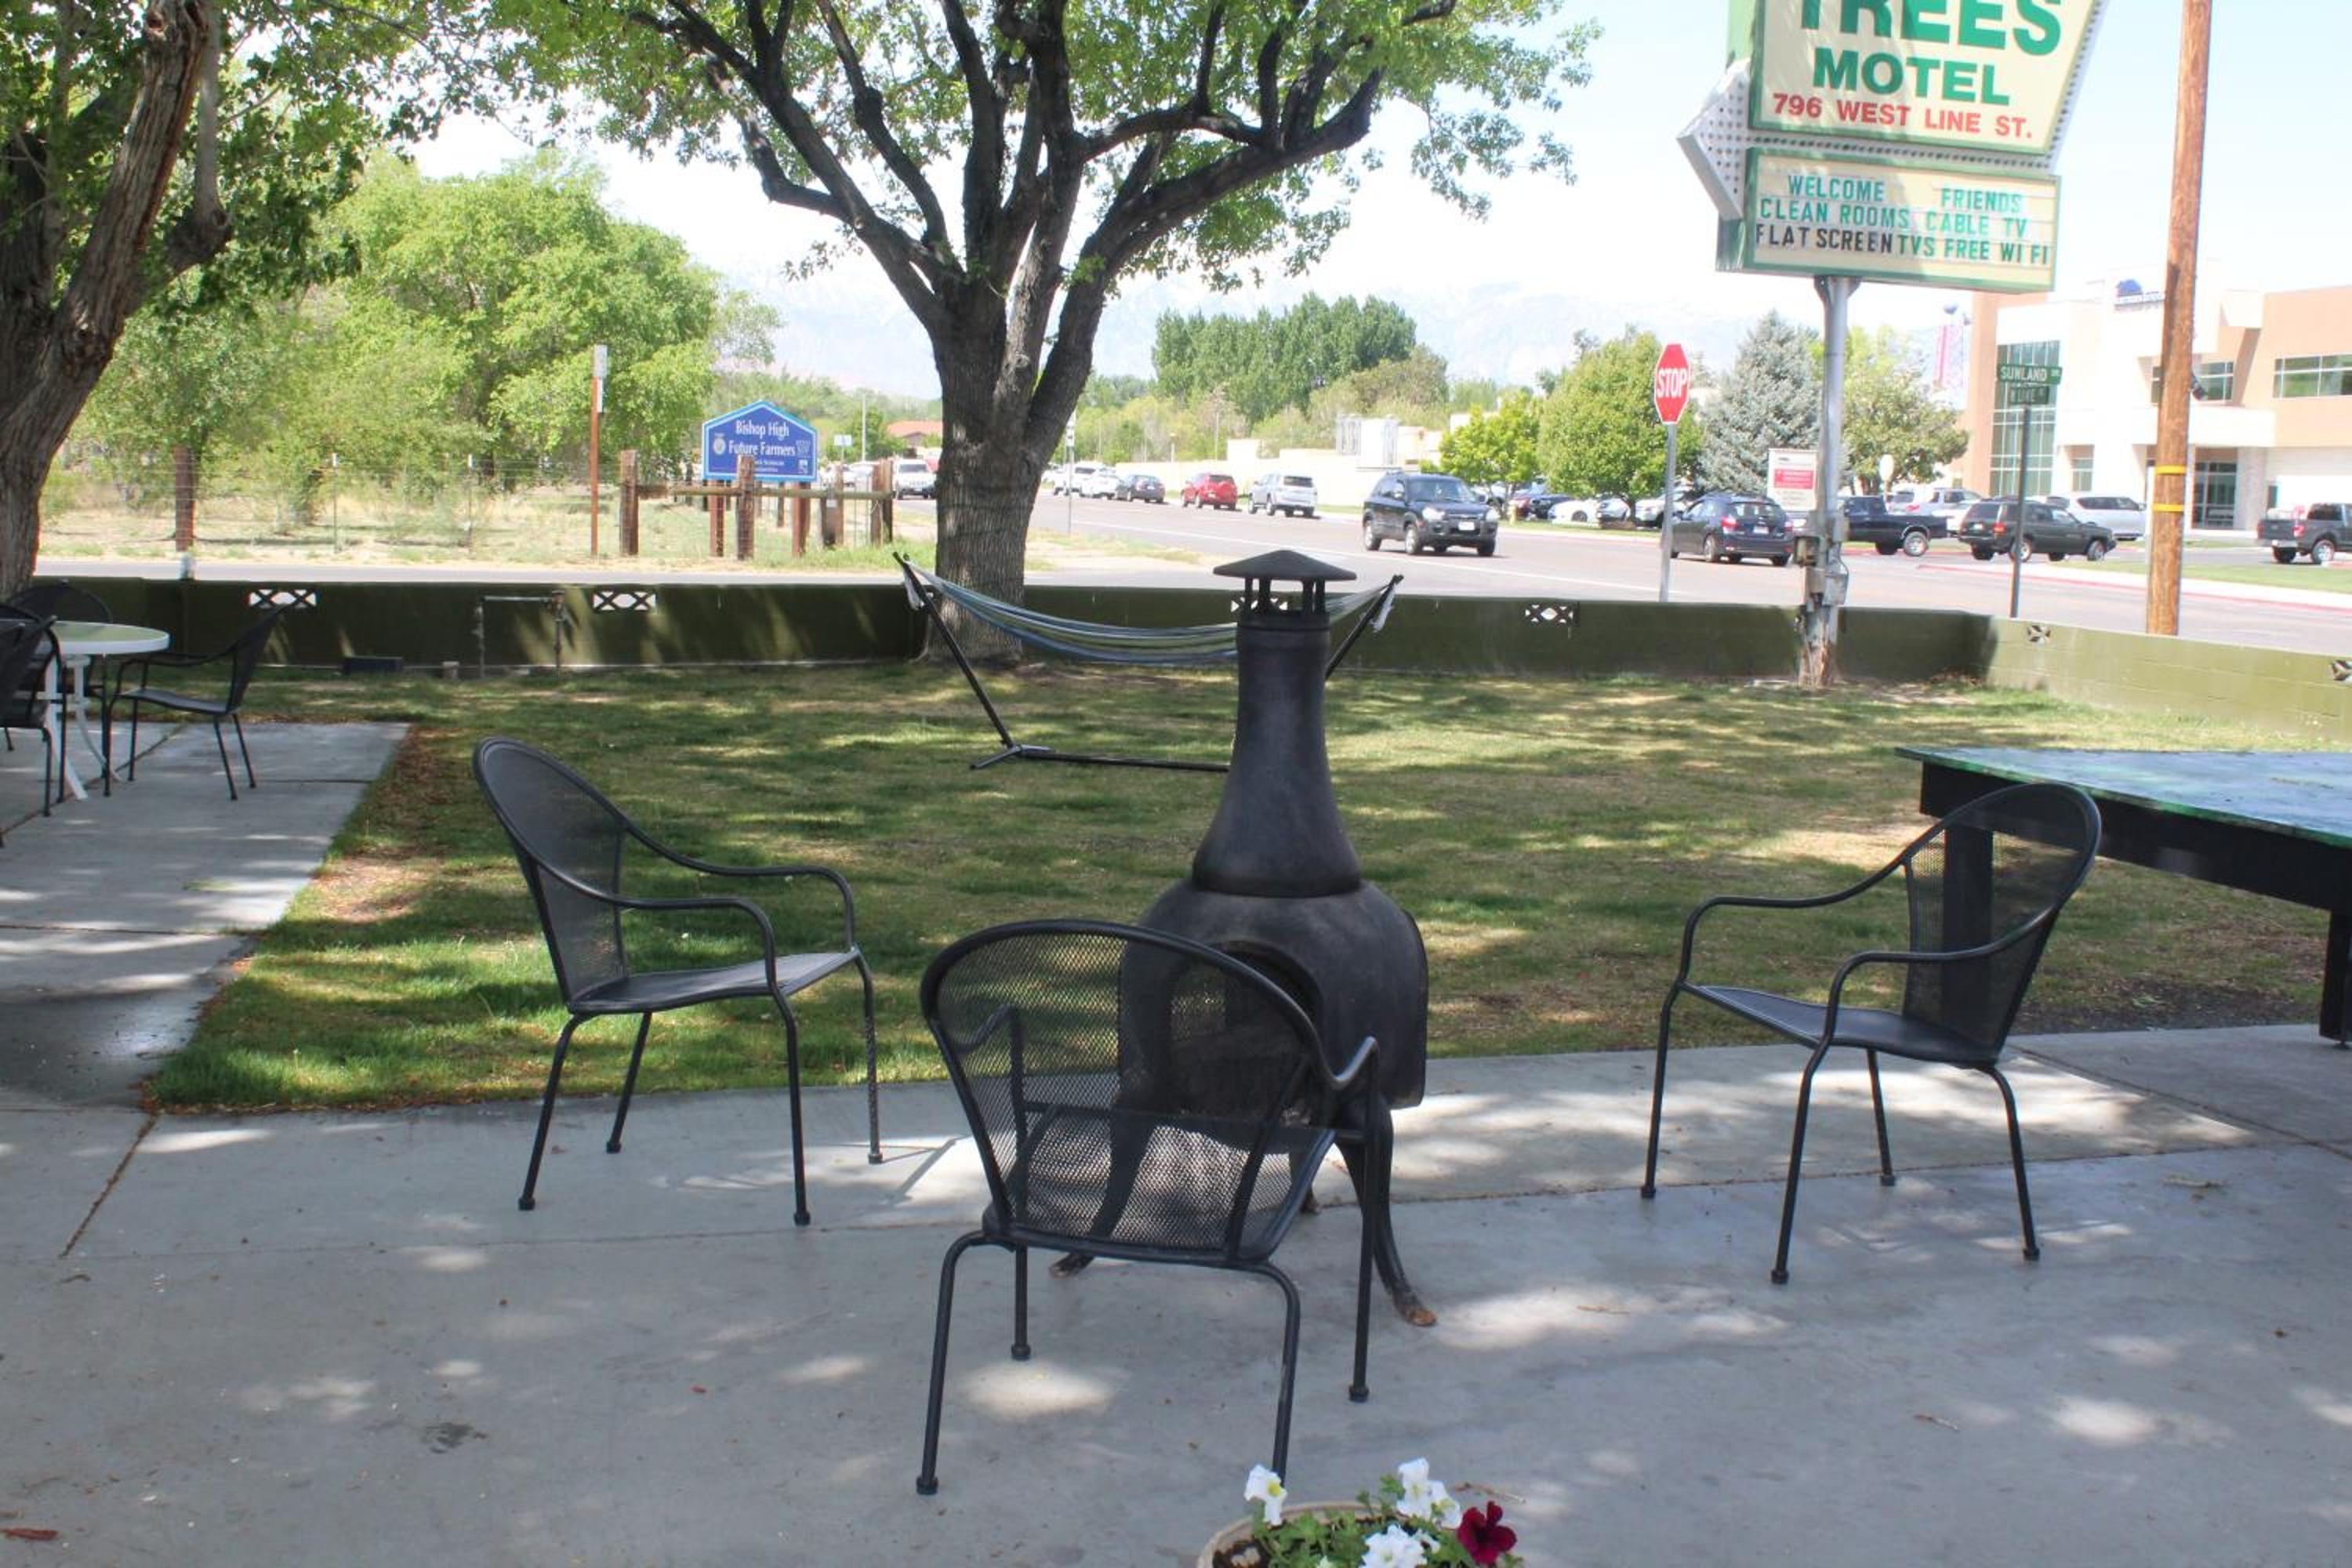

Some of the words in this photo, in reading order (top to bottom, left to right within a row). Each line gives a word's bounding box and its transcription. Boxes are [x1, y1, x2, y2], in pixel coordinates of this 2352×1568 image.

[1813, 47, 2009, 106] MOTEL
[1773, 93, 1823, 118] 796
[1837, 100, 1911, 126] WEST
[1925, 108, 1981, 133] LINE
[1996, 116, 2033, 139] ST.
[1788, 175, 1884, 201] WELCOME
[1940, 187, 2023, 213] FRIENDS
[1760, 198, 1828, 223] CLEAN
[1839, 203, 1910, 228] ROOMS
[1926, 210, 1990, 235] CABLE
[2004, 217, 2028, 238] TV
[1755, 223, 1810, 248] FLAT
[1816, 227, 1893, 253] SCREEN
[1898, 234, 1935, 257] TVS
[1944, 238, 1990, 260] FREE
[2001, 242, 2022, 263] WI
[2031, 245, 2049, 264] FI
[1657, 368, 1687, 398] STOP
[2000, 365, 2048, 382] SUNLAND
[728, 440, 757, 455] Future
[760, 441, 796, 456] Farmers
[735, 420, 766, 439] Bishop
[768, 421, 789, 441] High
